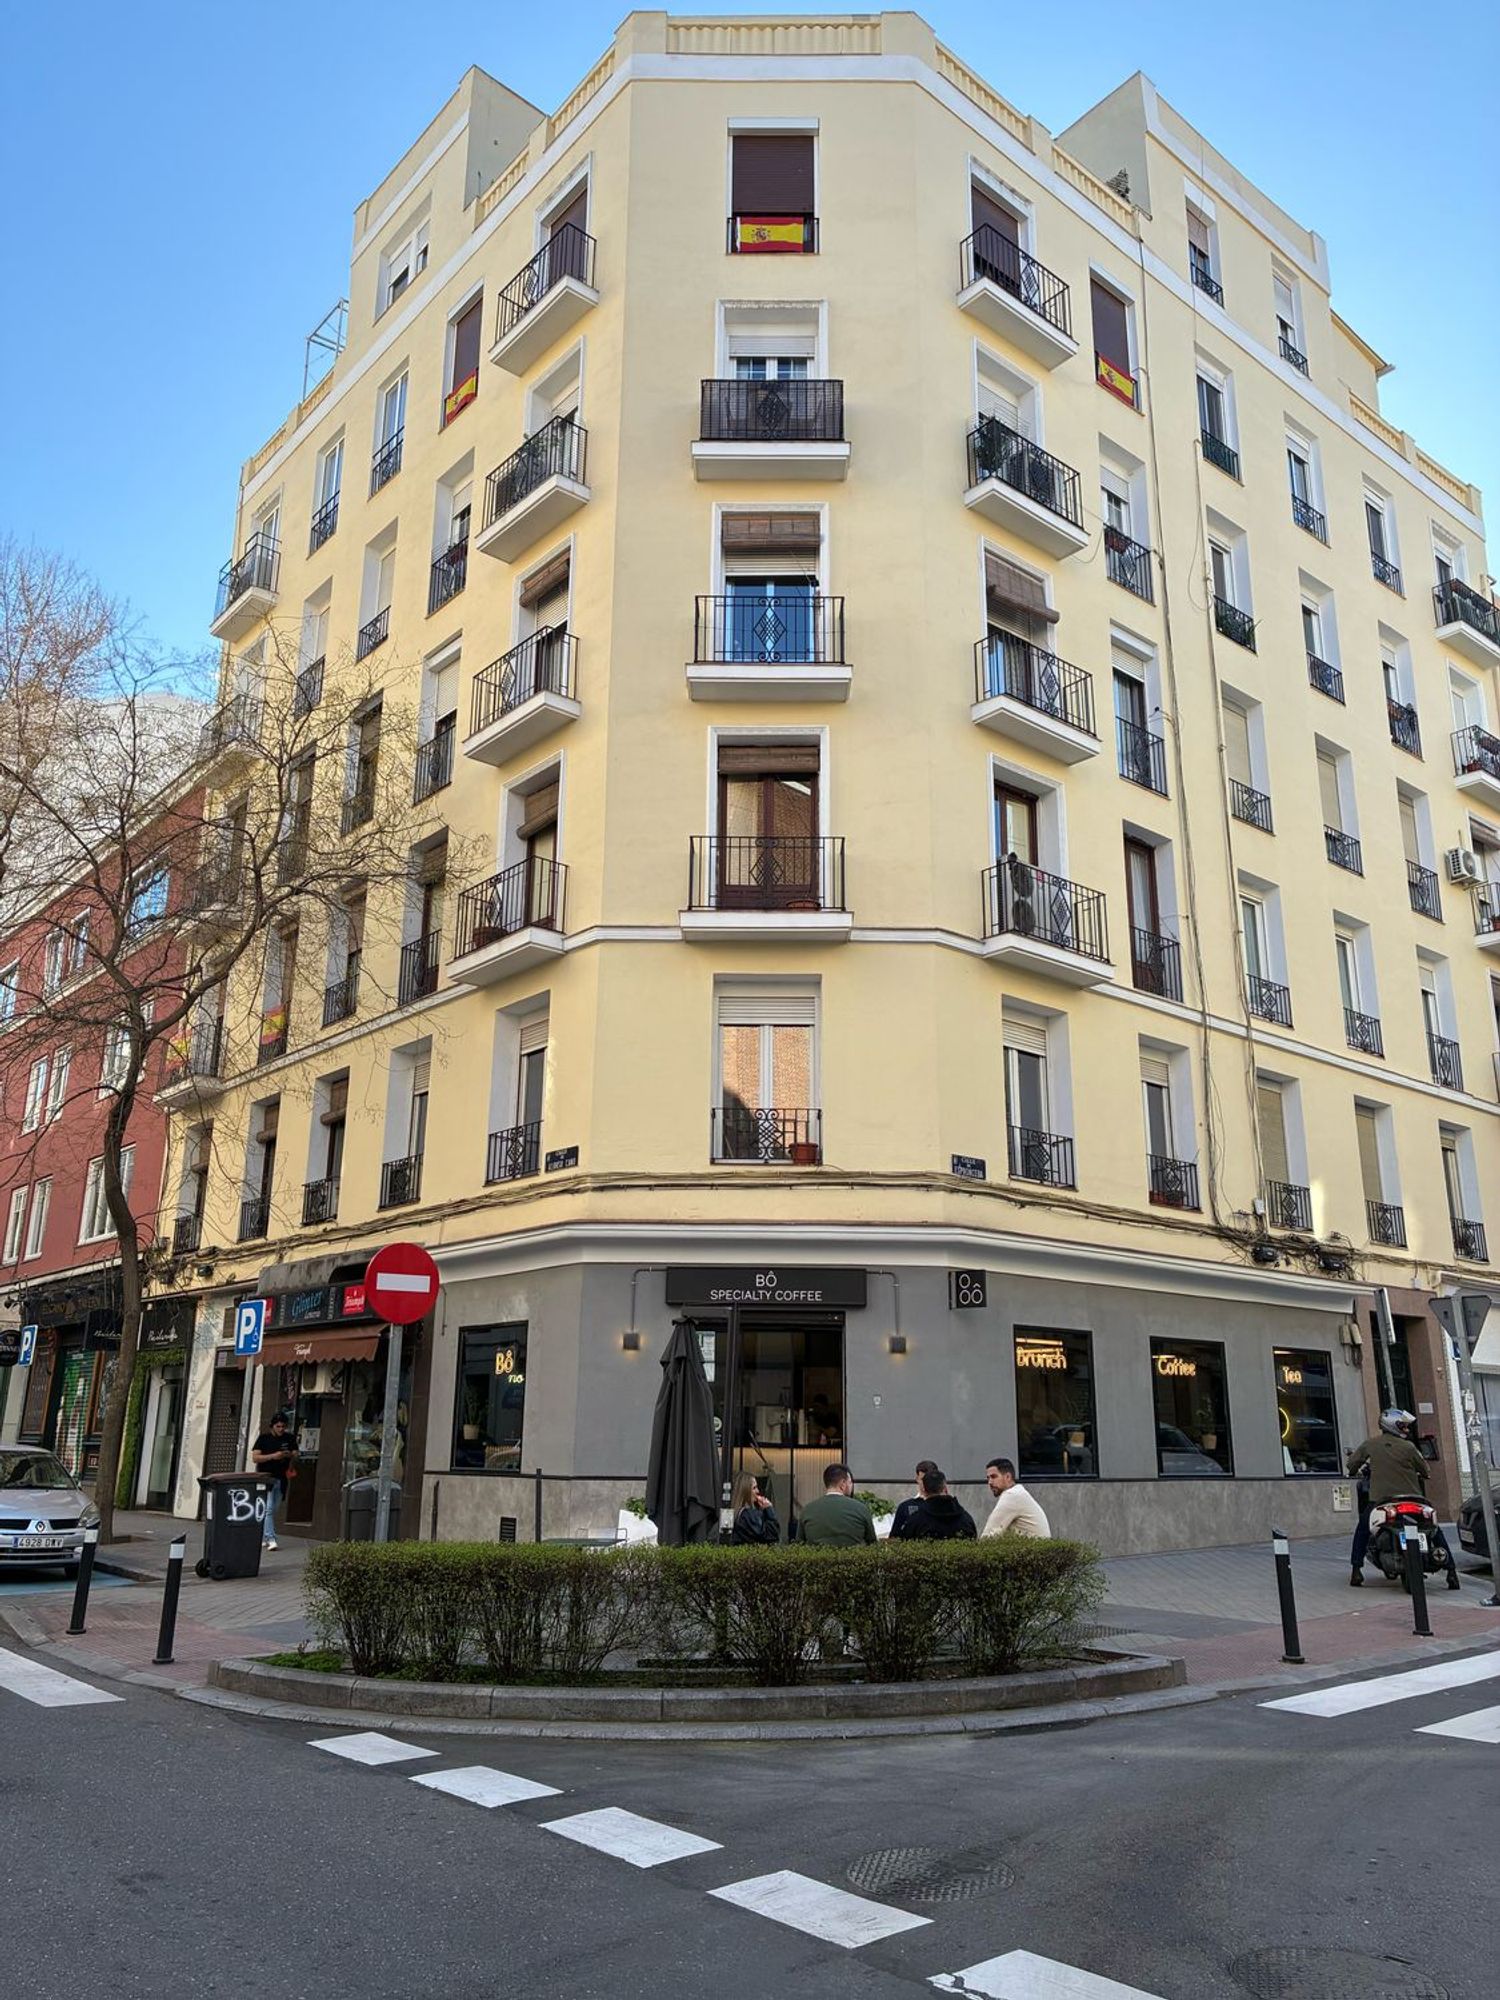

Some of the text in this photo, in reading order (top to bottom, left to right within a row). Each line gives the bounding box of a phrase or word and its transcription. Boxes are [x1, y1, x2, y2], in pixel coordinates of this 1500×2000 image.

[756, 1270, 777, 1287] BÔ
[710, 1289, 823, 1302] SPECIALTY COFFEE
[238, 1308, 257, 1349] P
[20, 1330, 32, 1362] P
[1157, 1358, 1196, 1376] Coffee
[1282, 1366, 1302, 1383] Tea
[20, 1537, 42, 1547] 4928
